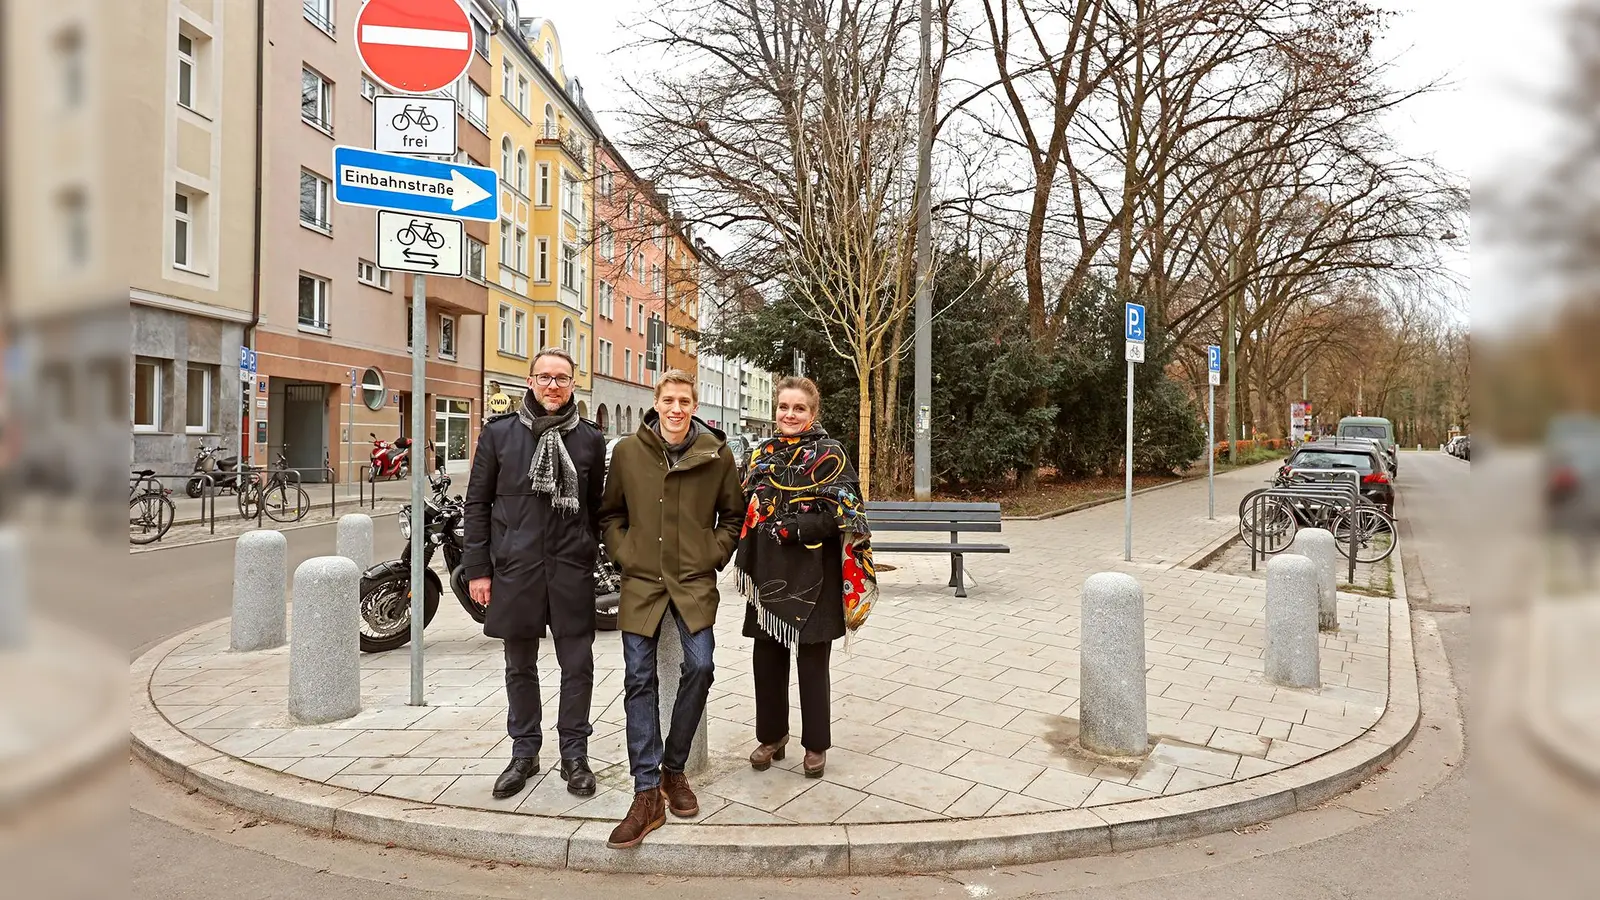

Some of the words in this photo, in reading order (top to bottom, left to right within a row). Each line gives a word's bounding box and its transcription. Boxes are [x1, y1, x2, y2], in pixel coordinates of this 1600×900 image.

[402, 135, 428, 148] frei
[345, 169, 454, 196] Einbahnstraße
[1129, 308, 1140, 336] P
[241, 349, 247, 366] P
[249, 353, 255, 370] P
[1210, 349, 1217, 368] P
